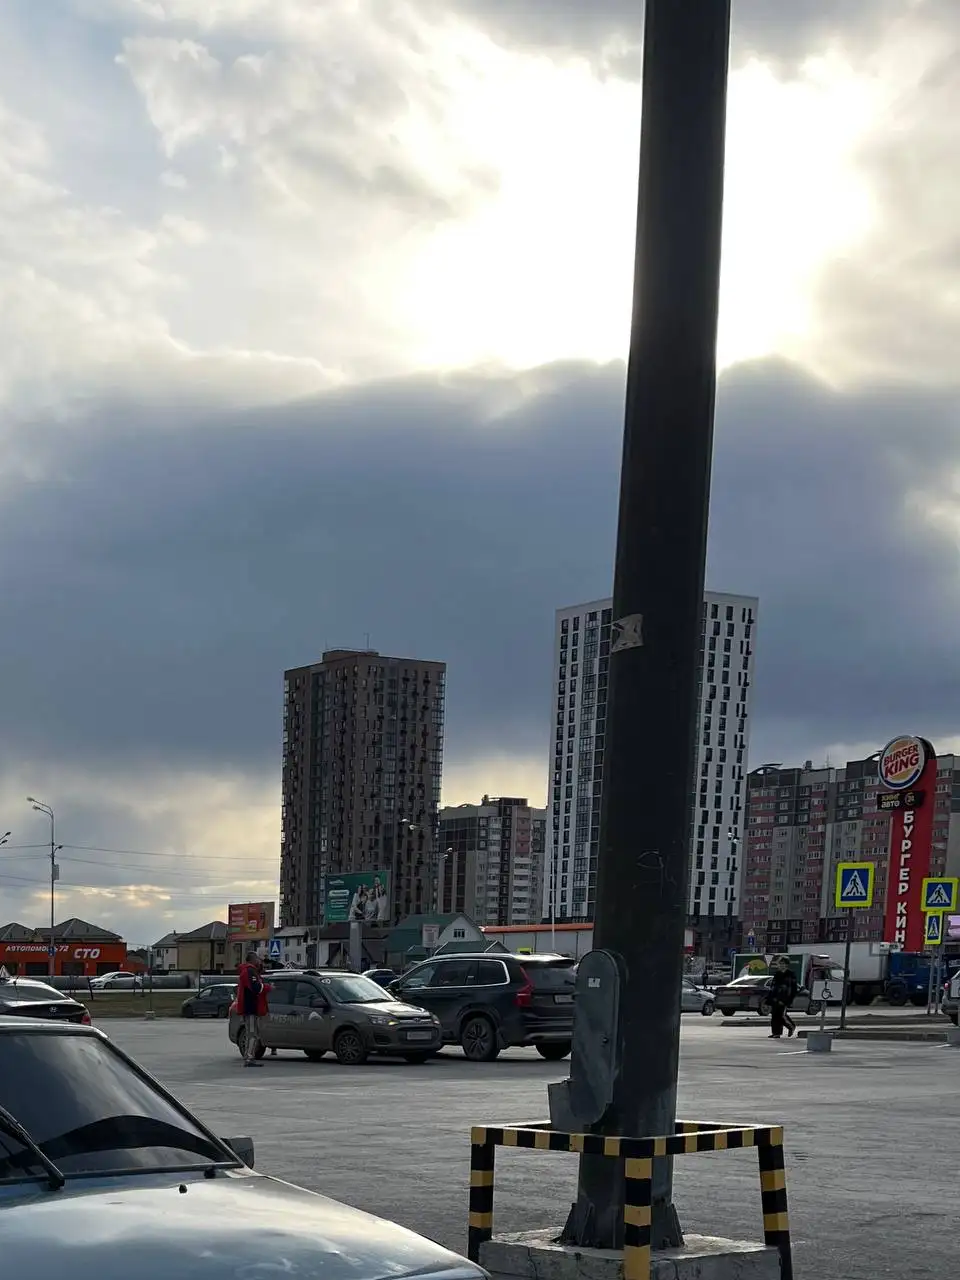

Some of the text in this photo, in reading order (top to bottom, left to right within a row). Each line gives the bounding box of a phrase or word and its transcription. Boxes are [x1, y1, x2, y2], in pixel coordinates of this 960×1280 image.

[884, 744, 919, 766] BURGER
[884, 753, 920, 779] KING
[894, 810, 915, 952] БУРГЕР КИН
[73, 948, 101, 959] СТО
